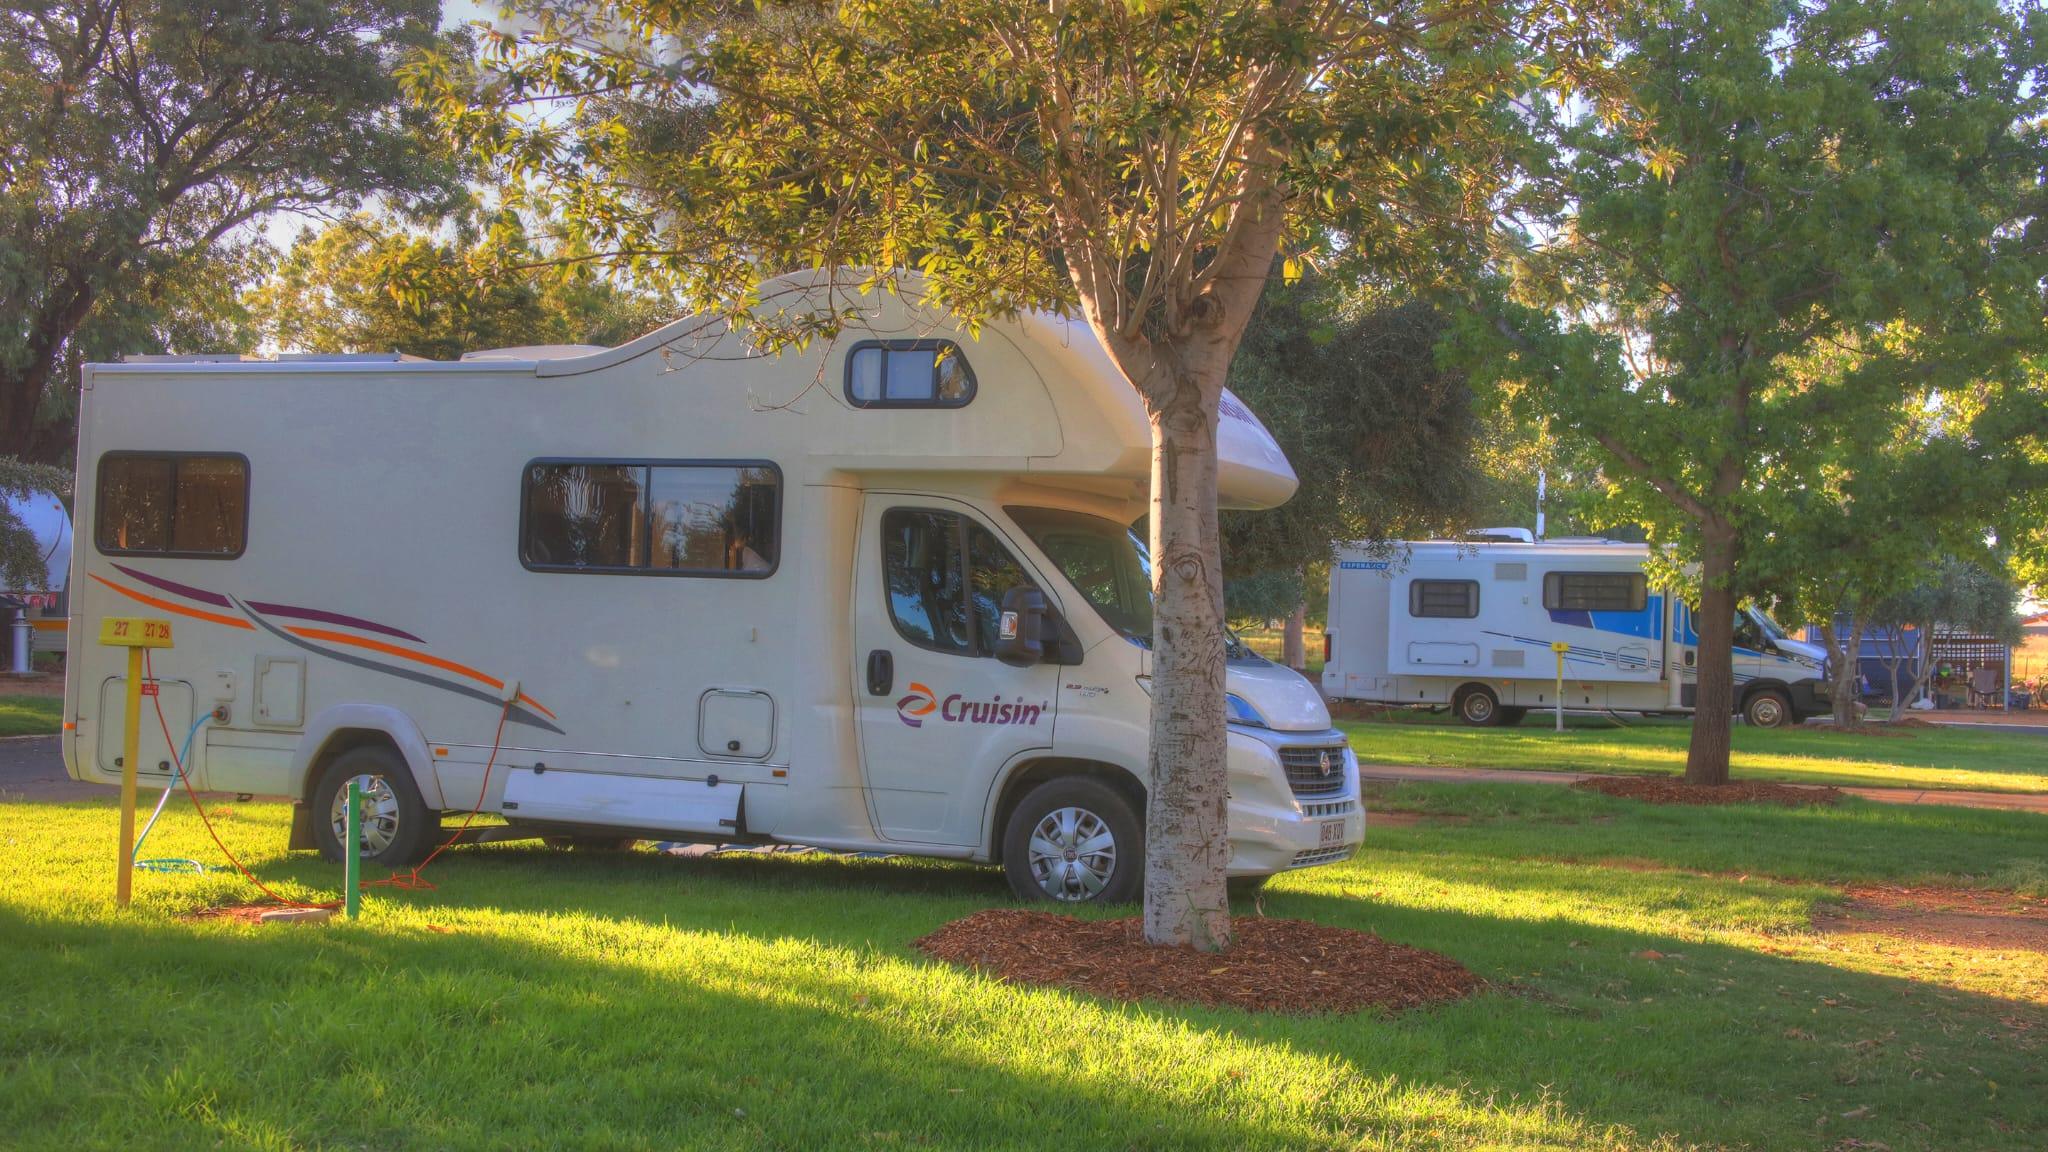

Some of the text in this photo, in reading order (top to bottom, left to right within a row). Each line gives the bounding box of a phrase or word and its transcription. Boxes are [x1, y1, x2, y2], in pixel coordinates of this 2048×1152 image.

[113, 621, 129, 637] 27
[144, 622, 169, 640] 27 28
[941, 694, 1048, 726] Cruisin'
